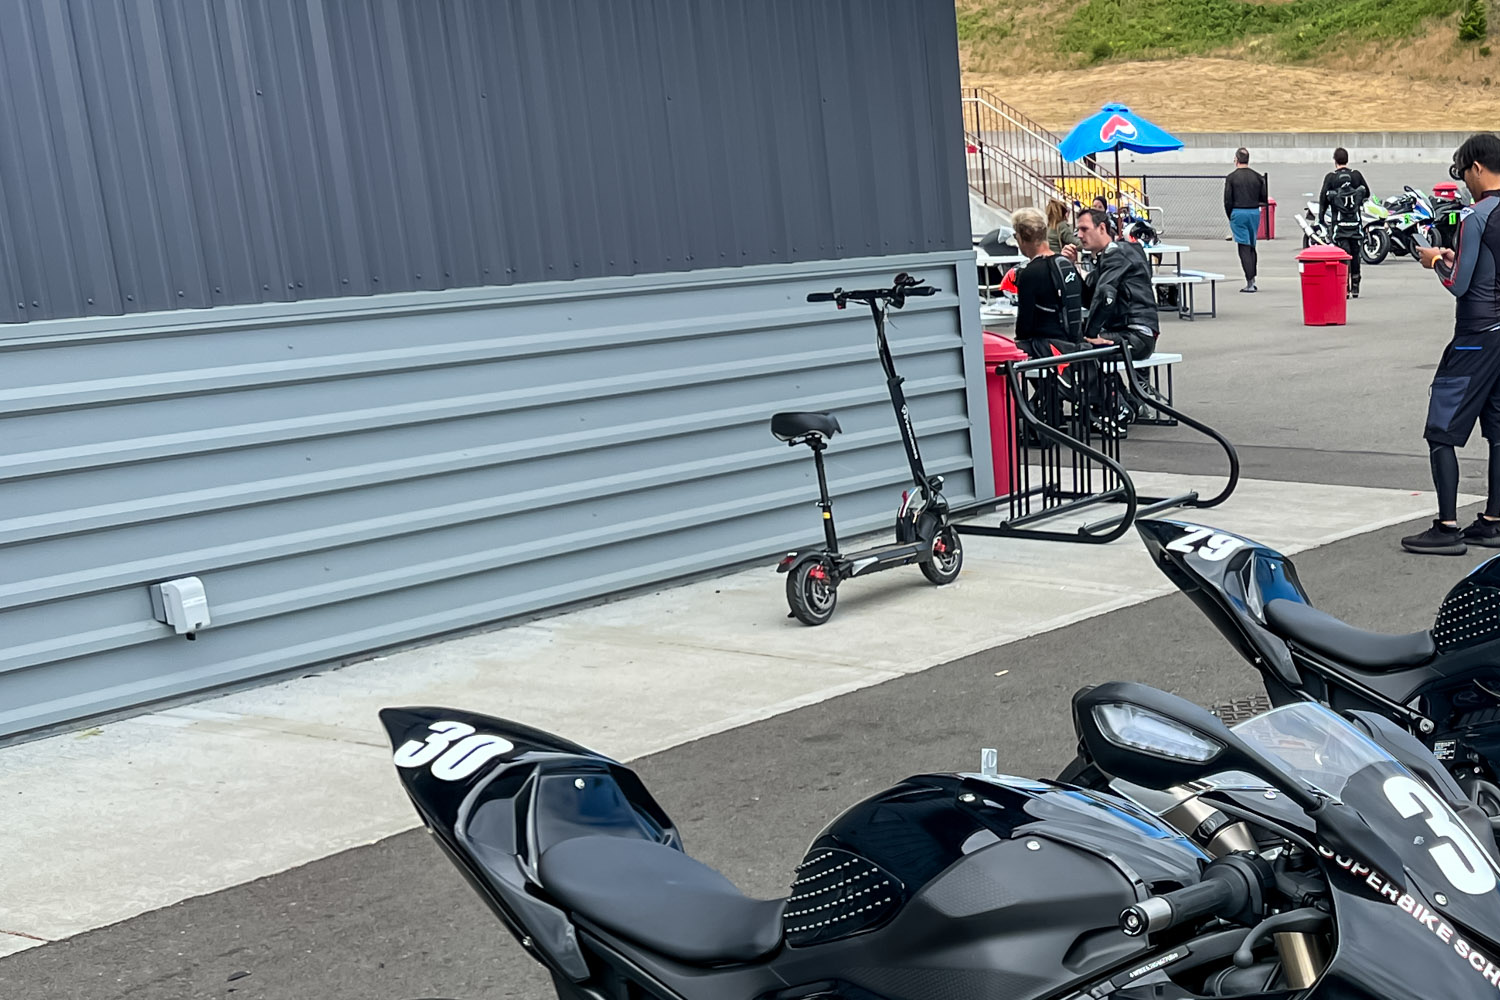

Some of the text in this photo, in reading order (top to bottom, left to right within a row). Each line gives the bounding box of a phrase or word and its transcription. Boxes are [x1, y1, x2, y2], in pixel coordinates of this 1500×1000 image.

[1165, 525, 1245, 562] 29
[393, 720, 515, 781] 30
[1383, 776, 1497, 895] 3
[1318, 845, 1454, 945] SUPERBIKE
